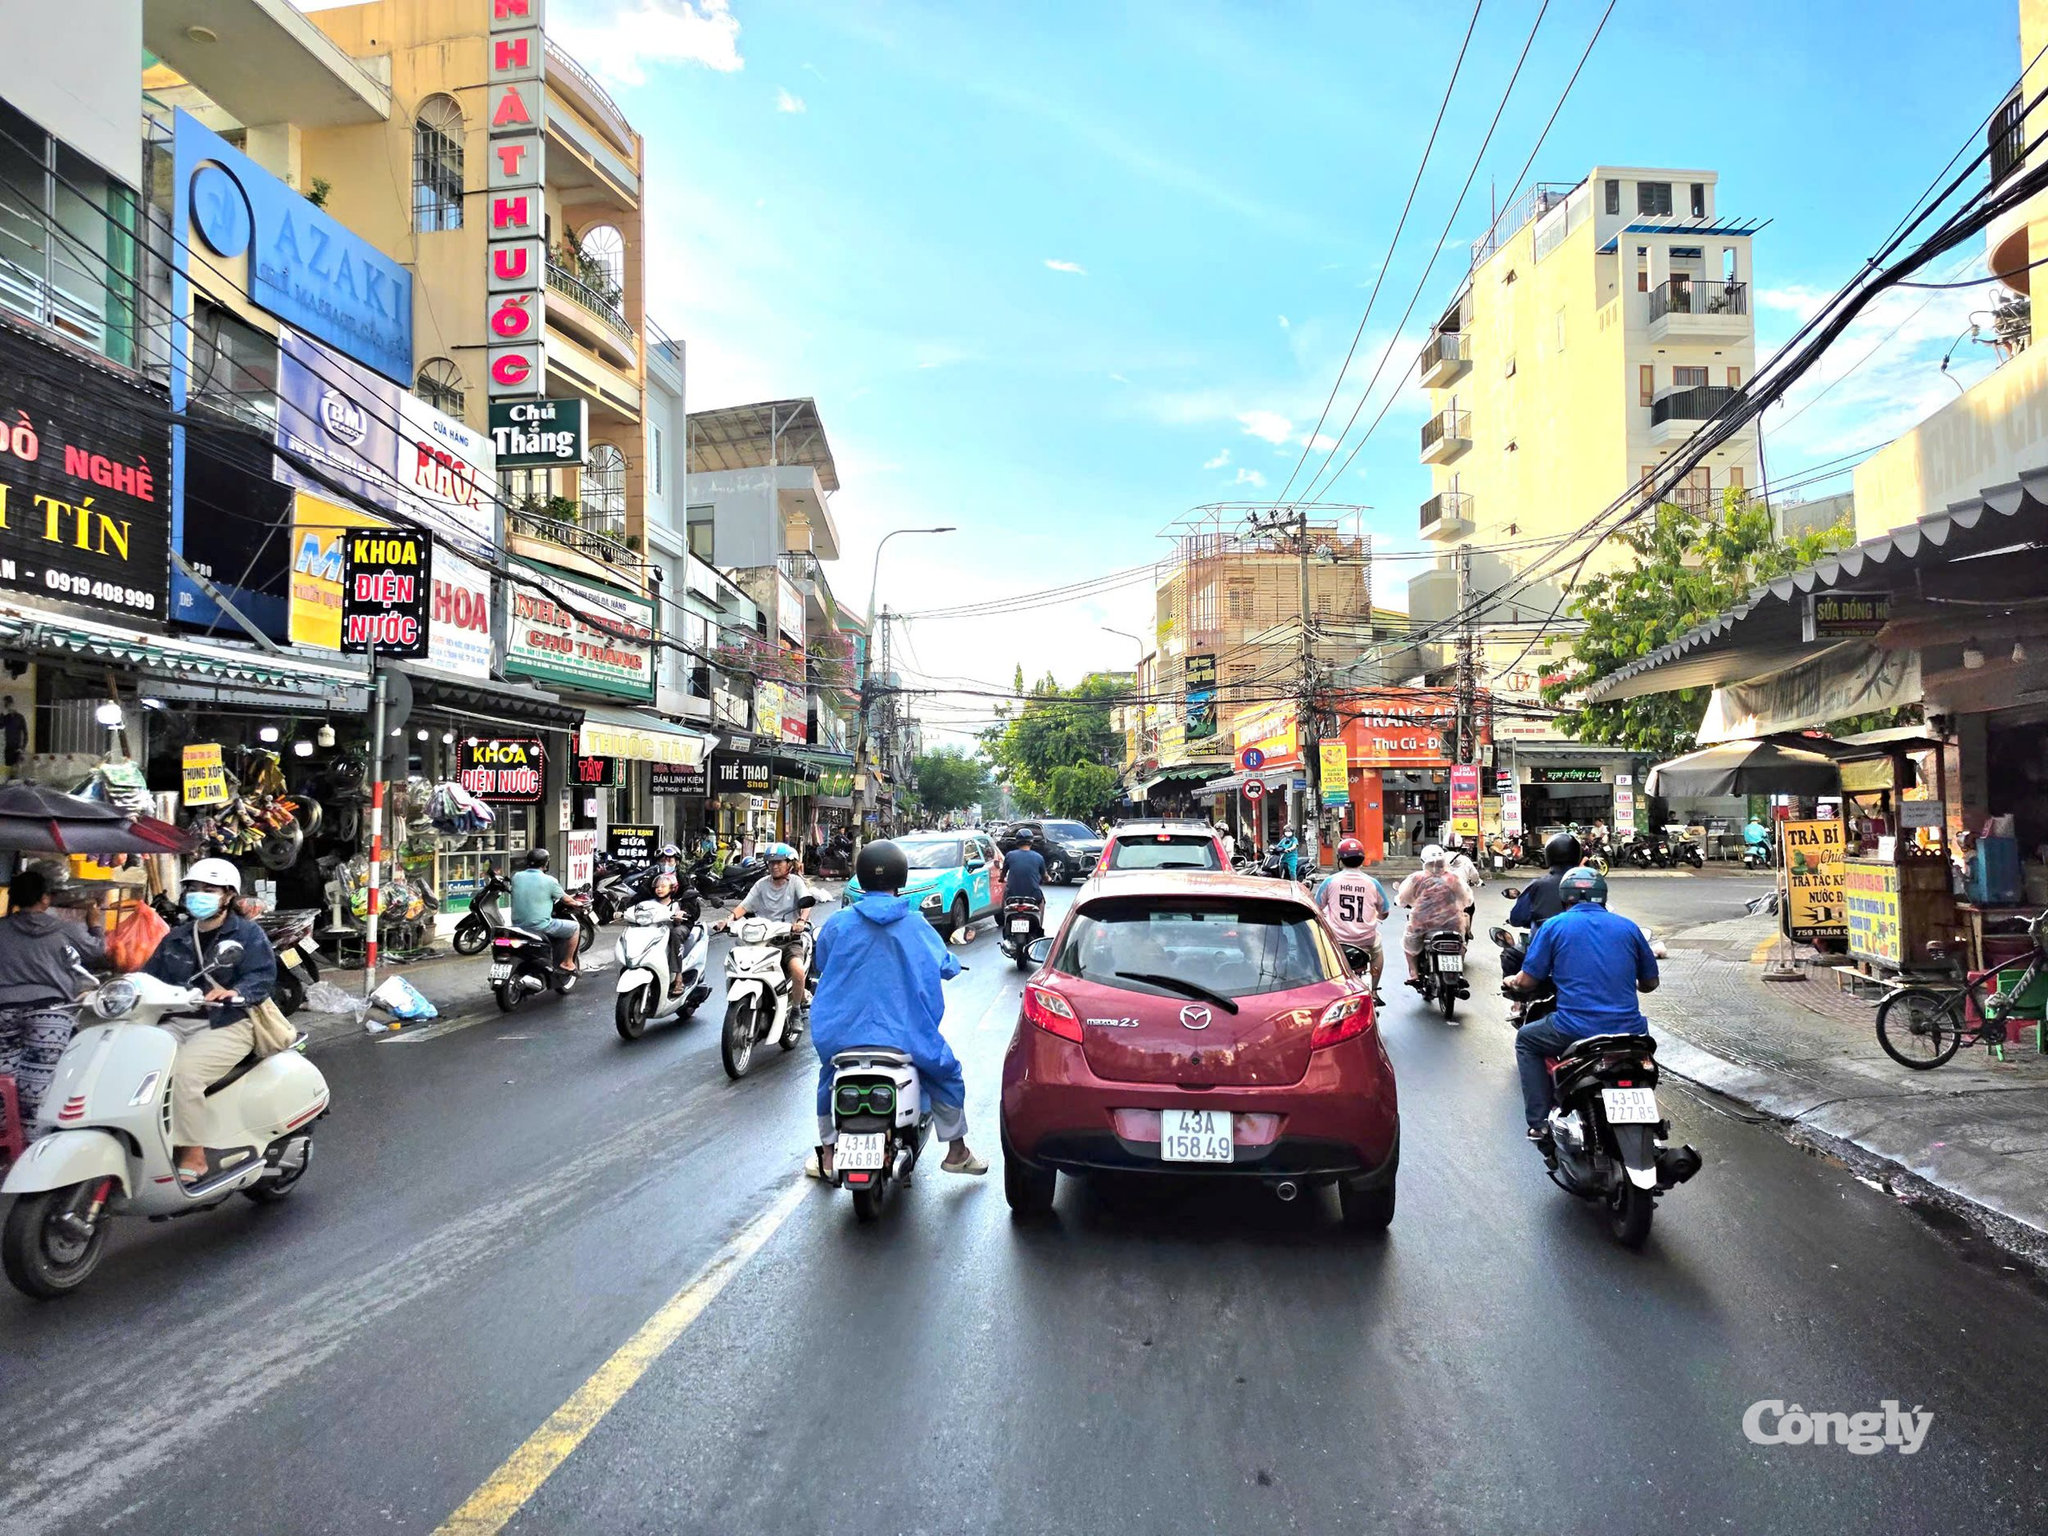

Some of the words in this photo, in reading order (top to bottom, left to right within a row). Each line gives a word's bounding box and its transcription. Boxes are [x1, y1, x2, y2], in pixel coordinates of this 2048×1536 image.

[274, 208, 402, 325] AZAKI
[509, 402, 556, 421] Chú
[492, 421, 576, 458] Thắng
[65, 444, 154, 503] NGHỀ
[33, 494, 133, 562] TÍN
[354, 539, 418, 565] KHOA
[355, 569, 415, 608] ĐIỆN
[349, 611, 417, 645] NƯỚC
[526, 628, 573, 655] CHÚ
[576, 637, 643, 670] THẮNG
[473, 747, 527, 764] KHOA
[587, 730, 654, 758] THUỐC
[659, 738, 692, 763] TÂY
[1373, 737, 1397, 750] Thu
[1400, 737, 1417, 750] Cũ
[578, 754, 604, 781] TÂY
[653, 774, 668, 783] BÁN
[670, 775, 686, 783] LINH
[687, 775, 704, 785] KIỆN
[720, 759, 739, 780] THỂ
[742, 765, 768, 780] THAO
[460, 766, 495, 797] ĐIỆN
[499, 766, 538, 794] NƯỚC
[747, 780, 769, 789] Shop
[568, 832, 593, 857] THUỐC
[1788, 825, 1819, 846] TRÀ
[1823, 824, 1839, 844] BÍ
[573, 860, 588, 880] TÂY
[1792, 872, 1811, 887] TRÀ
[1354, 885, 1365, 893] AN
[1339, 894, 1365, 923] 51
[1087, 1018, 1119, 1026] mazda
[1179, 1111, 1216, 1135] 43A
[845, 1136, 877, 1151] 43-AA
[1167, 1135, 1230, 1159] 158.49
[839, 1152, 881, 1167] 746.88
